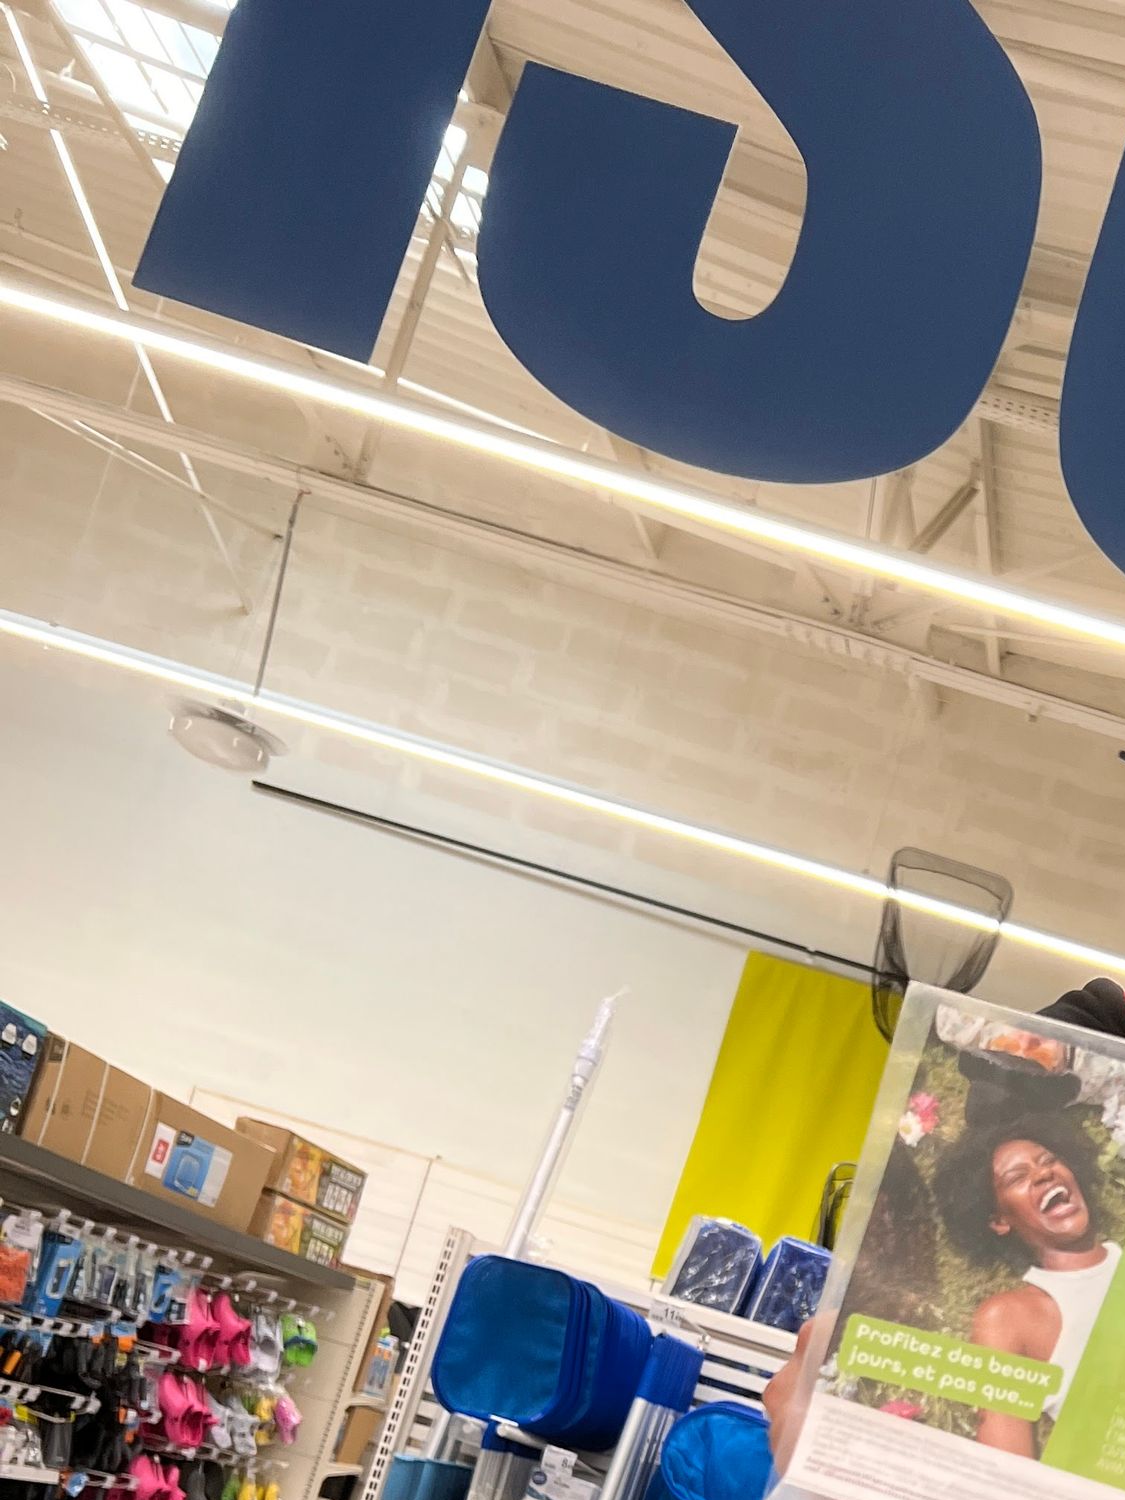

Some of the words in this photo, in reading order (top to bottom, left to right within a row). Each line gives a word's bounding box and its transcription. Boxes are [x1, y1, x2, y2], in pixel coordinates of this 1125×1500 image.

[848, 1345, 907, 1377] jours,
[912, 1364, 935, 1381] et
[940, 1371, 976, 1393] pas
[982, 1383, 1035, 1409] que...
[856, 1323, 943, 1360] Profitez
[948, 1348, 983, 1370] des
[988, 1355, 1051, 1387] beaux
